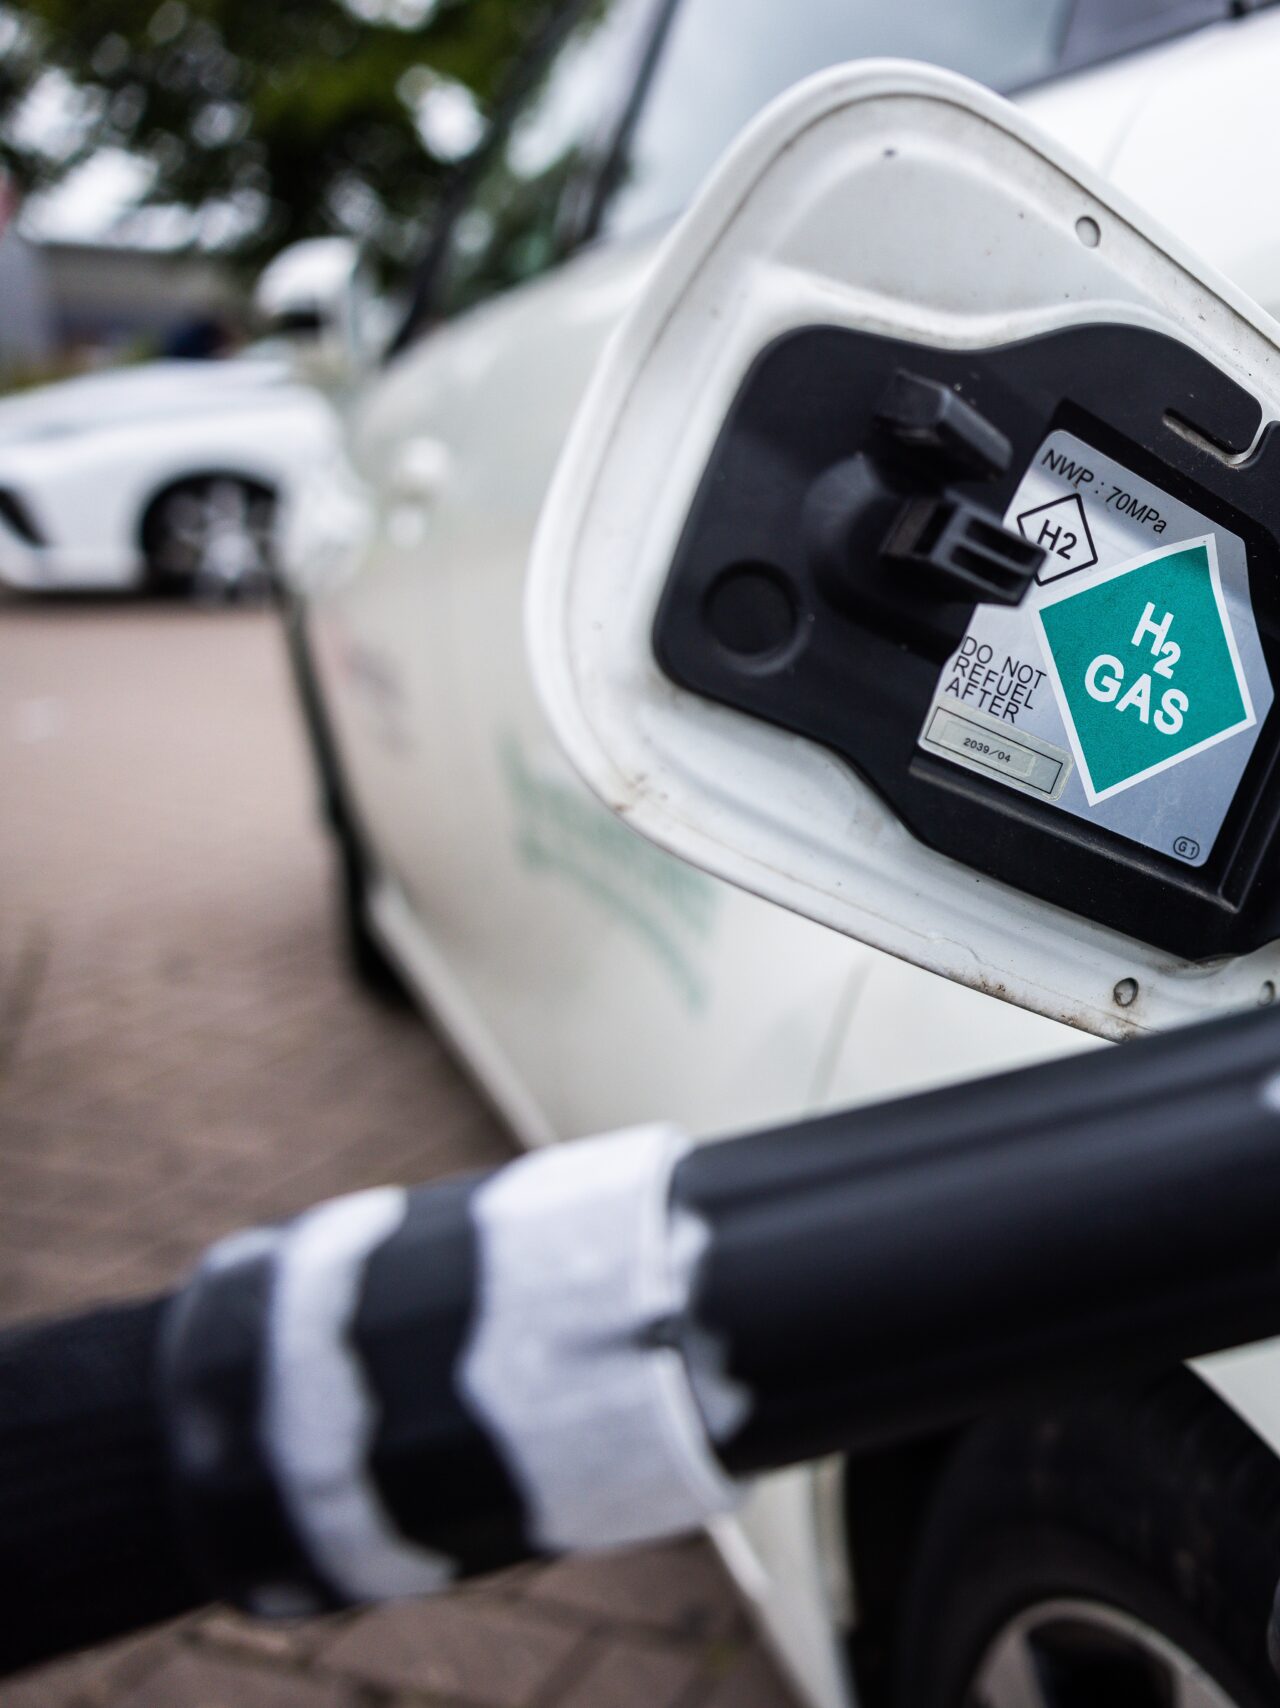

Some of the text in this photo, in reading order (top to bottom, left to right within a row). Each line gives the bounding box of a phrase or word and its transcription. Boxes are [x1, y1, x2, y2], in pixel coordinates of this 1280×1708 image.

[1041, 449, 1094, 485] NWP
[1105, 486, 1167, 534] 70MPa
[1037, 519, 1077, 560] H2
[961, 636, 1047, 689] DO NOT
[1131, 601, 1181, 679] H2
[945, 677, 1020, 724] AFTER
[952, 655, 1034, 710] REFUEL
[1084, 654, 1189, 735] GAS
[963, 737, 1011, 764] 2039/04
